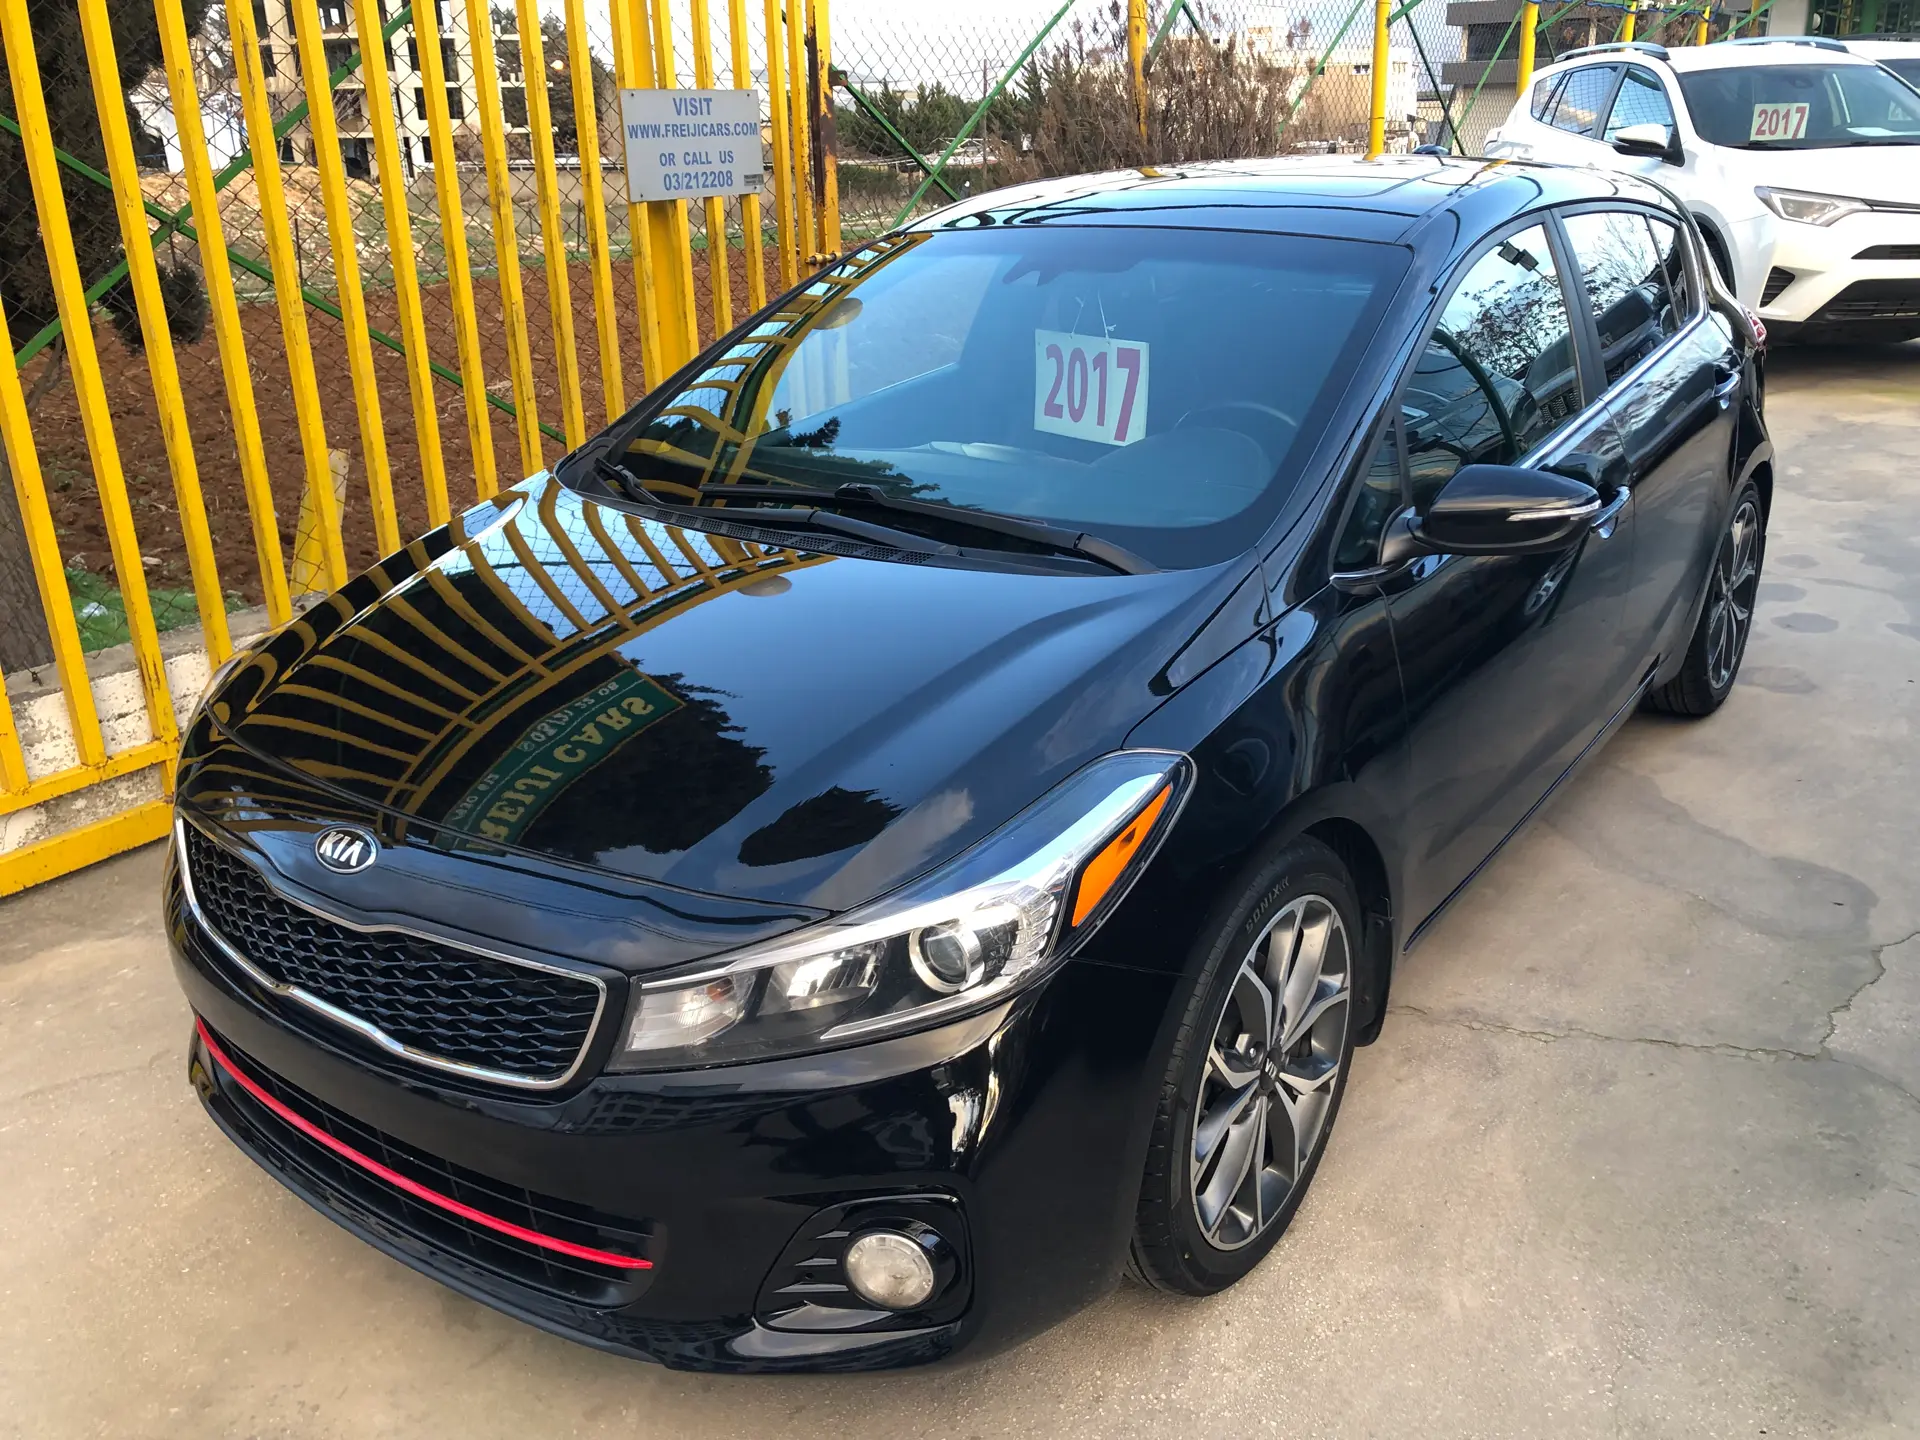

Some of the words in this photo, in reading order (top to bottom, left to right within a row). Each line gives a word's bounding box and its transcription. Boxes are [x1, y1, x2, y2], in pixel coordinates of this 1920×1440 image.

[672, 97, 713, 116] VISIT
[627, 122, 758, 139] WWW.FREIJICARS.COM
[1755, 105, 1807, 140] 2017
[659, 152, 676, 167] OR
[683, 151, 712, 166] CALL
[719, 150, 734, 164] US
[663, 170, 734, 191] 03/212208
[1044, 343, 1141, 442] 2017
[319, 831, 364, 867] KIA
